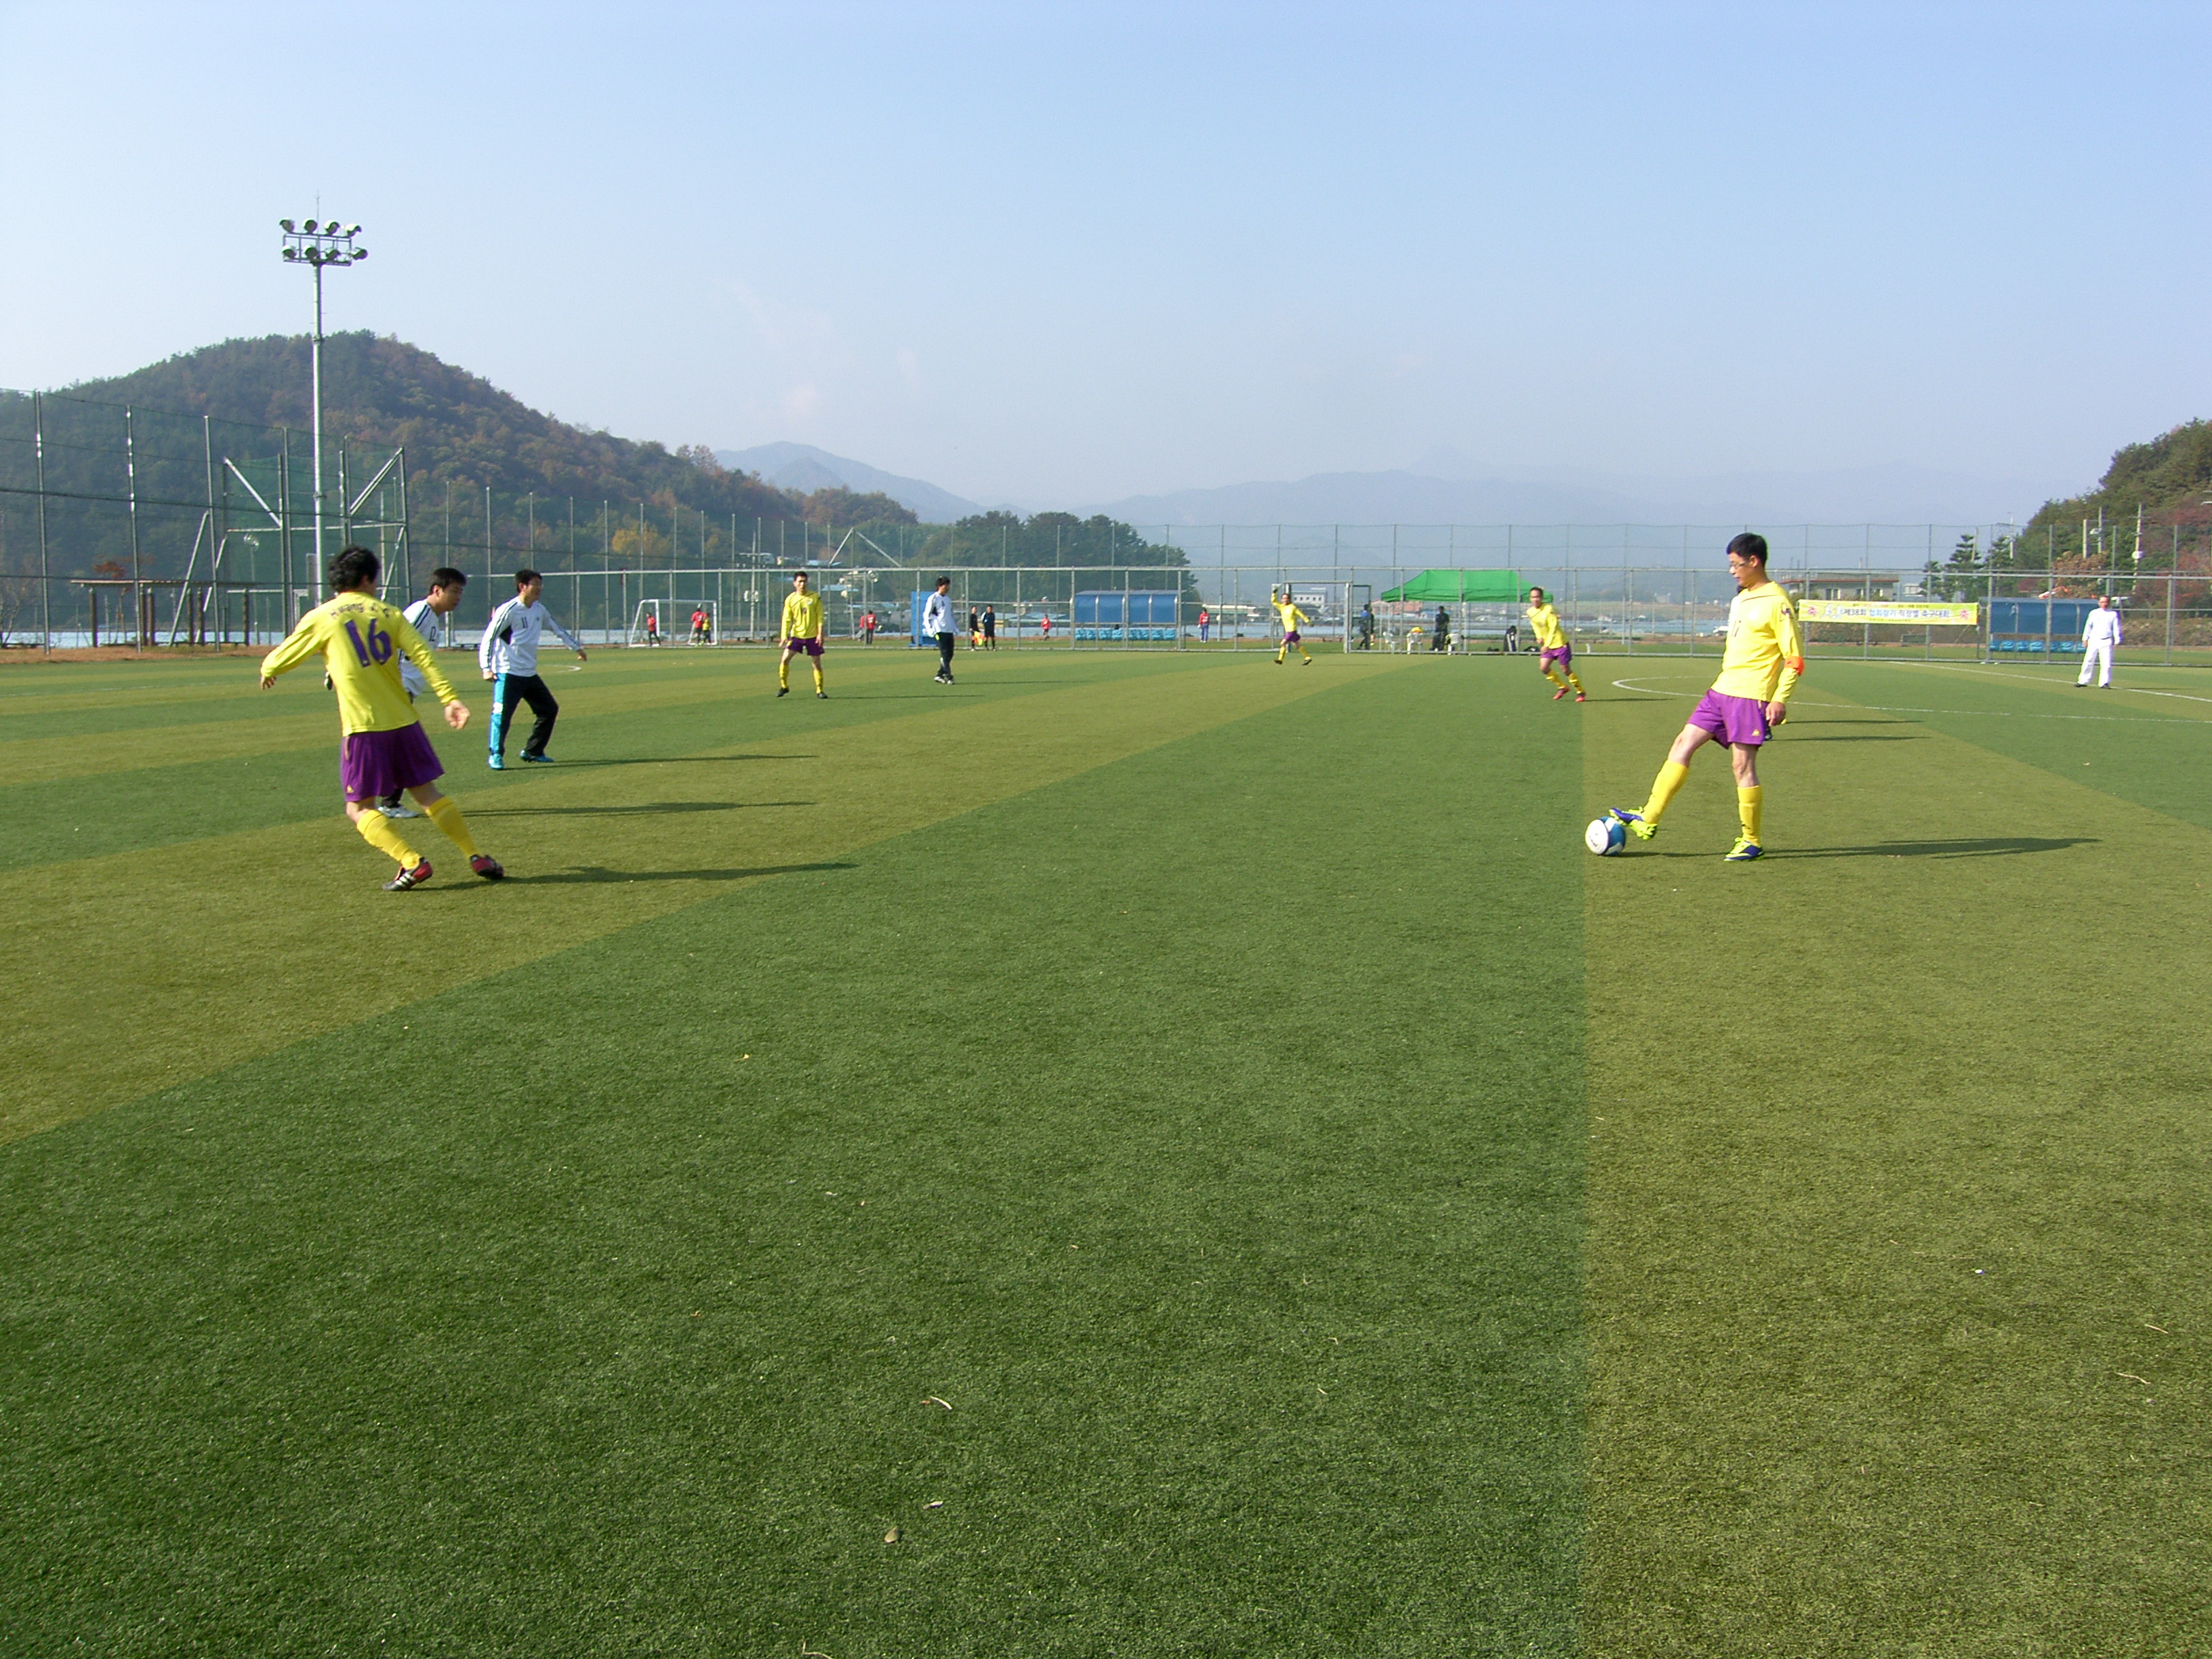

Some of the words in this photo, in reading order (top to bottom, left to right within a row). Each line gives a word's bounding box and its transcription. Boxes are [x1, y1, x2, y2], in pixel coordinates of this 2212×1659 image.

[1843, 608, 1867, 616] 제38회
[1921, 609, 1950, 618] 축구대회
[344, 617, 392, 668] 16
